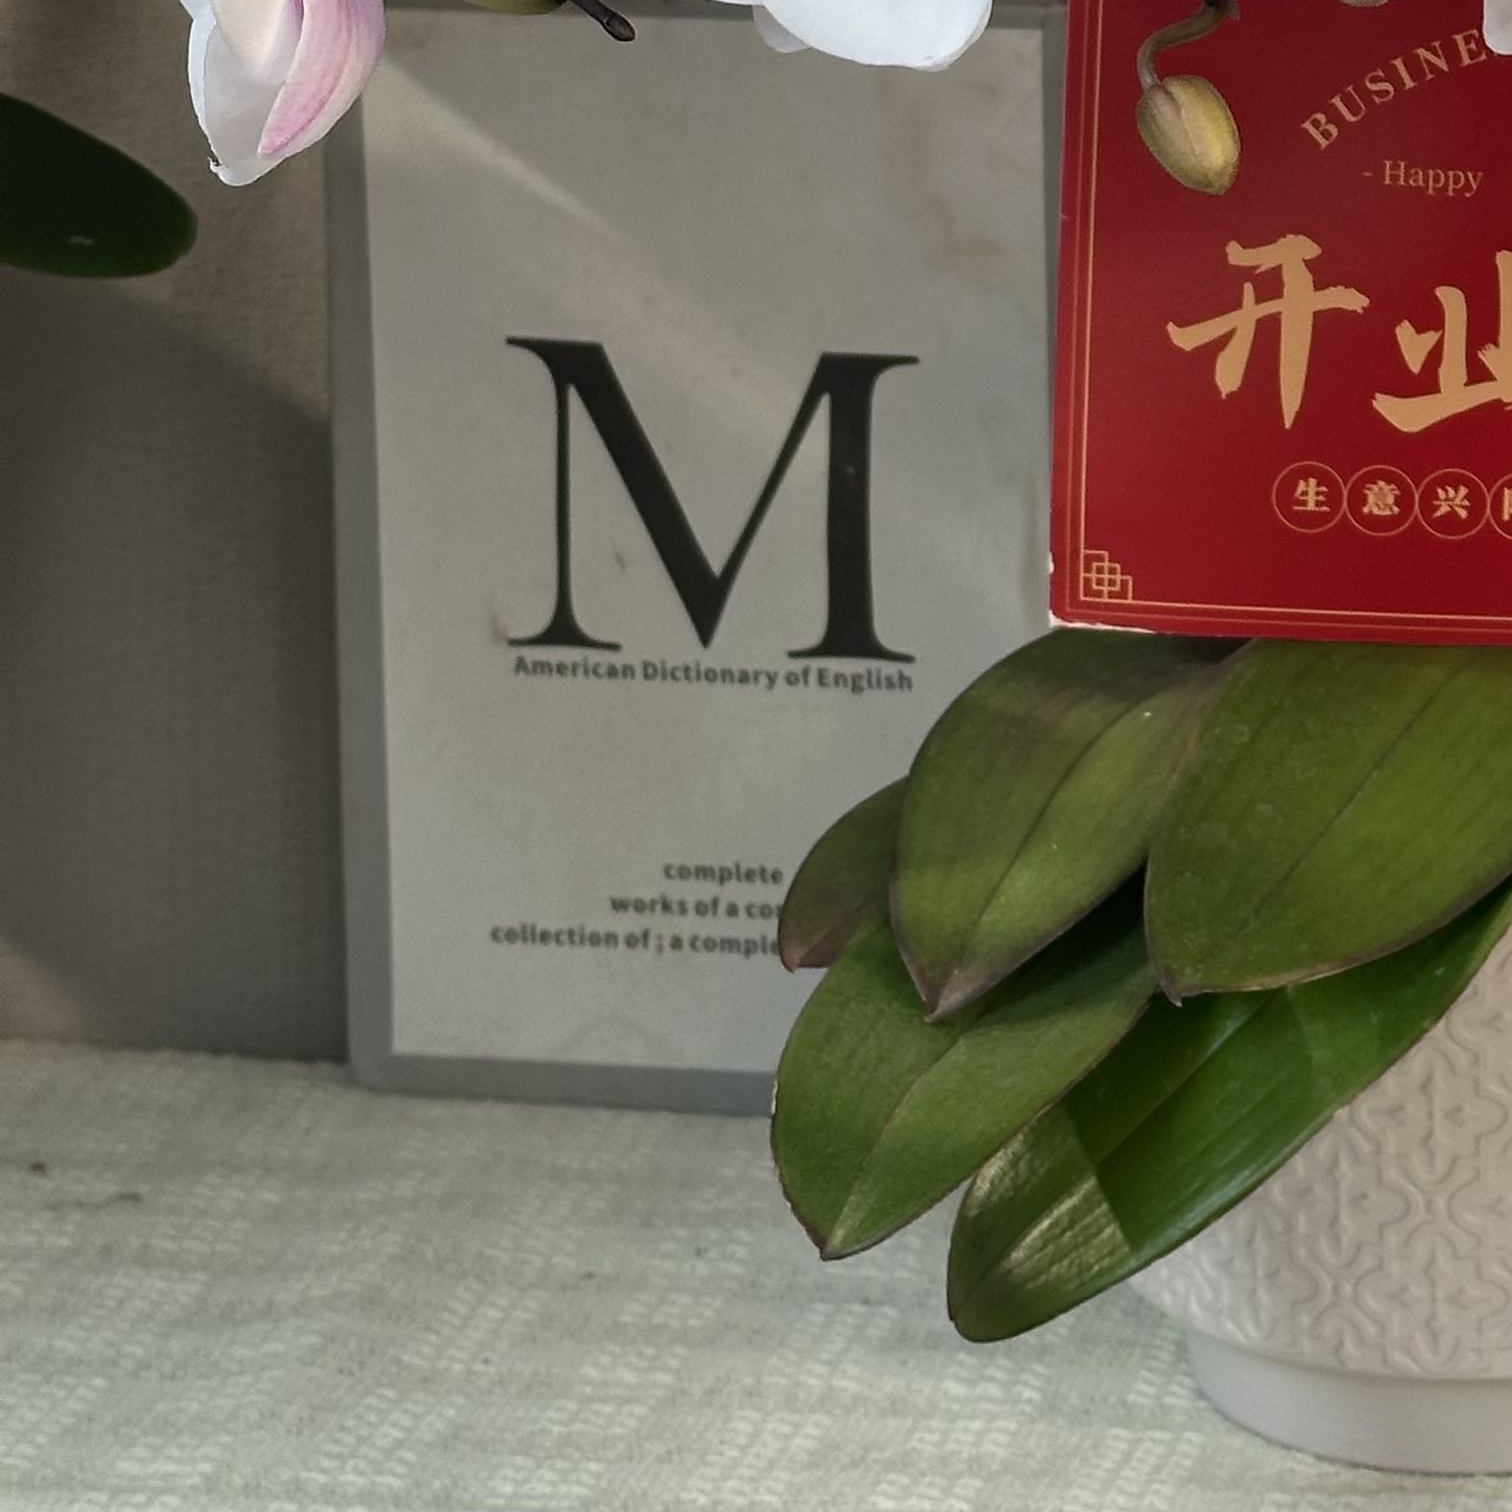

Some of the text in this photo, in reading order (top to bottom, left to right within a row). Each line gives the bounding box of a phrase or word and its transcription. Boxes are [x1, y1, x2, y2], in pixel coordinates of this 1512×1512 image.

[1300, 28, 1488, 150] BUSINE
[1383, 159, 1483, 199] Happy
[506, 336, 920, 664] M
[514, 655, 914, 693] American Dictionary of English
[662, 861, 784, 888] complete
[609, 893, 689, 918] works
[693, 895, 720, 918] of
[725, 901, 740, 919] a
[490, 922, 620, 950] collection
[623, 928, 651, 950] of
[668, 933, 685, 952] a
[688, 934, 780, 960] comple
